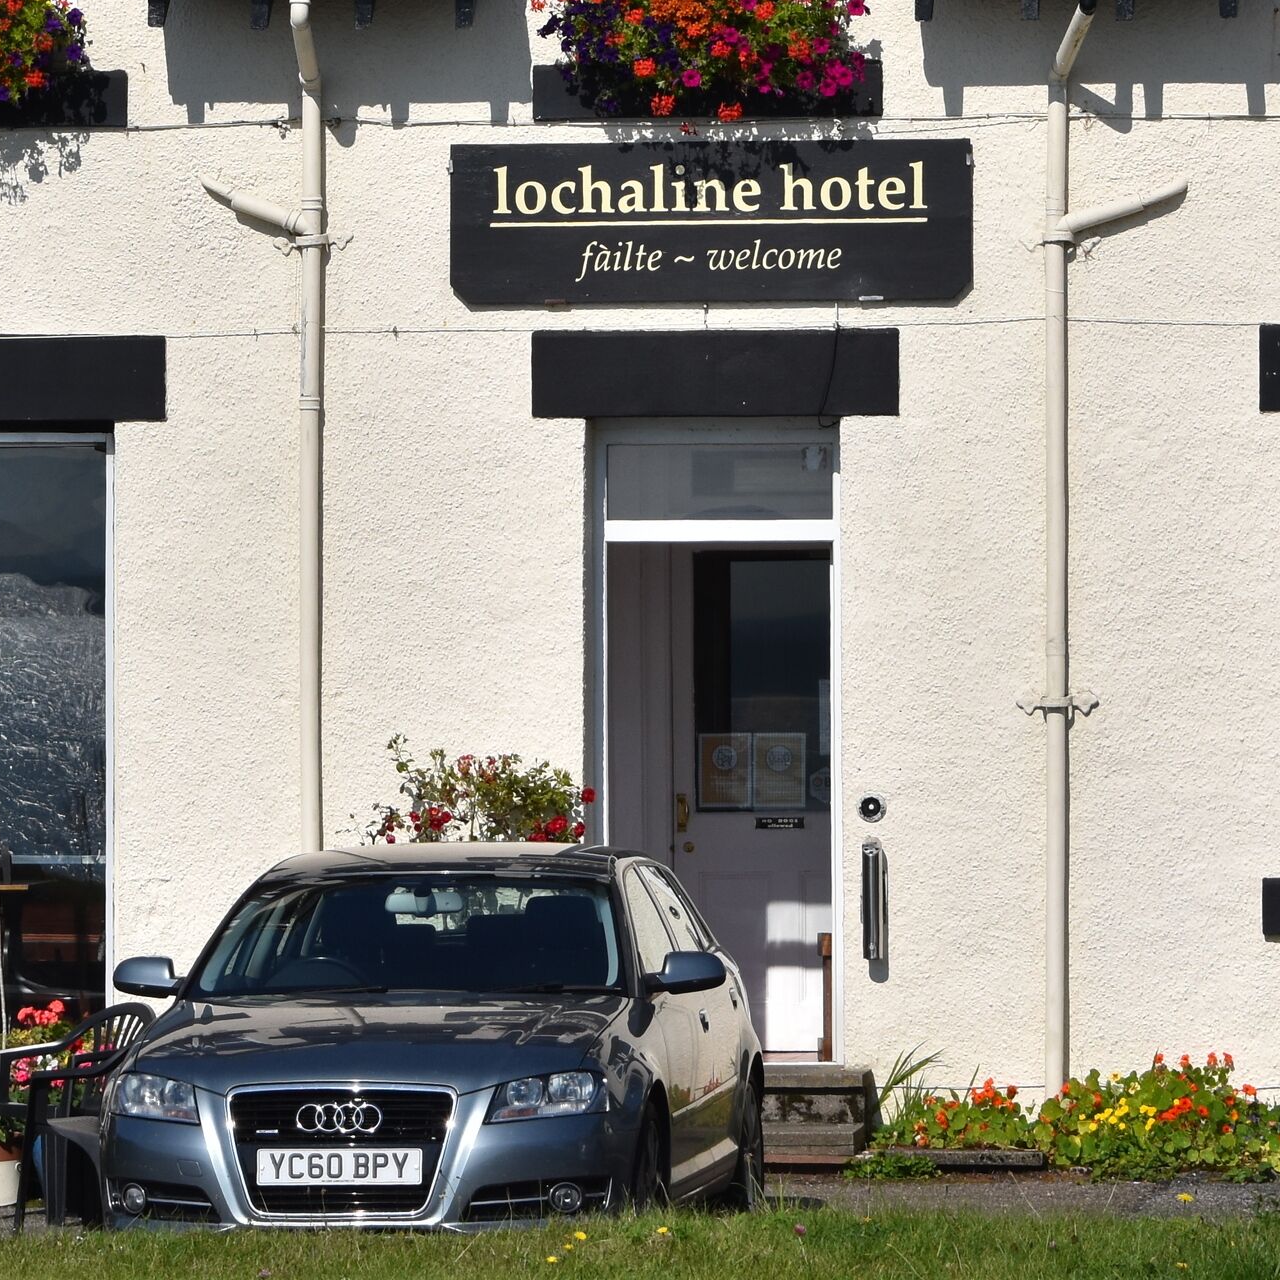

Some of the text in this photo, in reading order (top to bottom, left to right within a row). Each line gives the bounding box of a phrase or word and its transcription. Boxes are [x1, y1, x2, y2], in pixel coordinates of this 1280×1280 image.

[493, 160, 928, 215] lochaline hotel
[575, 240, 663, 282] fàilte
[706, 238, 842, 270] welcome
[269, 1152, 409, 1179] YC60 BPY
